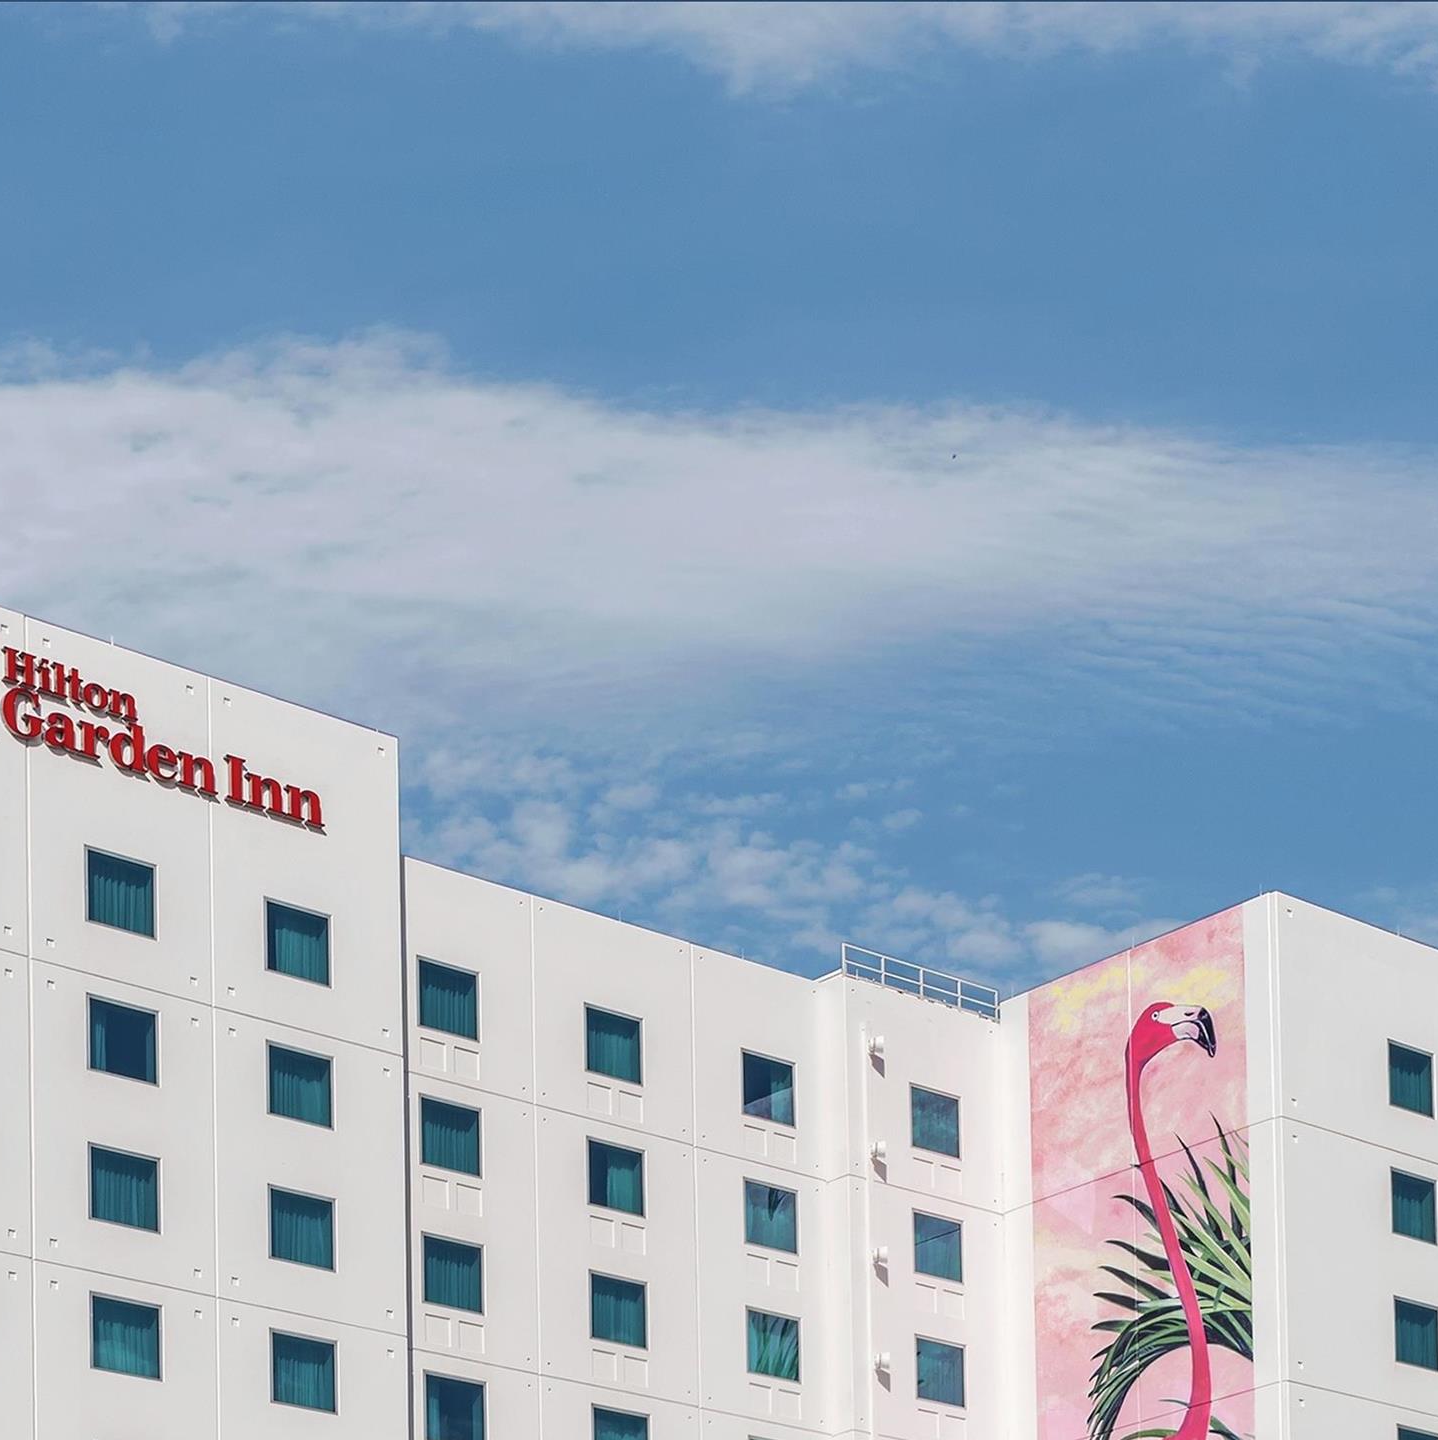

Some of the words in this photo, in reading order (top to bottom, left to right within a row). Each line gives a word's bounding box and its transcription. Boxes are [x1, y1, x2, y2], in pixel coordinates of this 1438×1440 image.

[2, 646, 139, 722] Hilton
[1, 687, 219, 797] Garden
[225, 754, 326, 829] Inn
